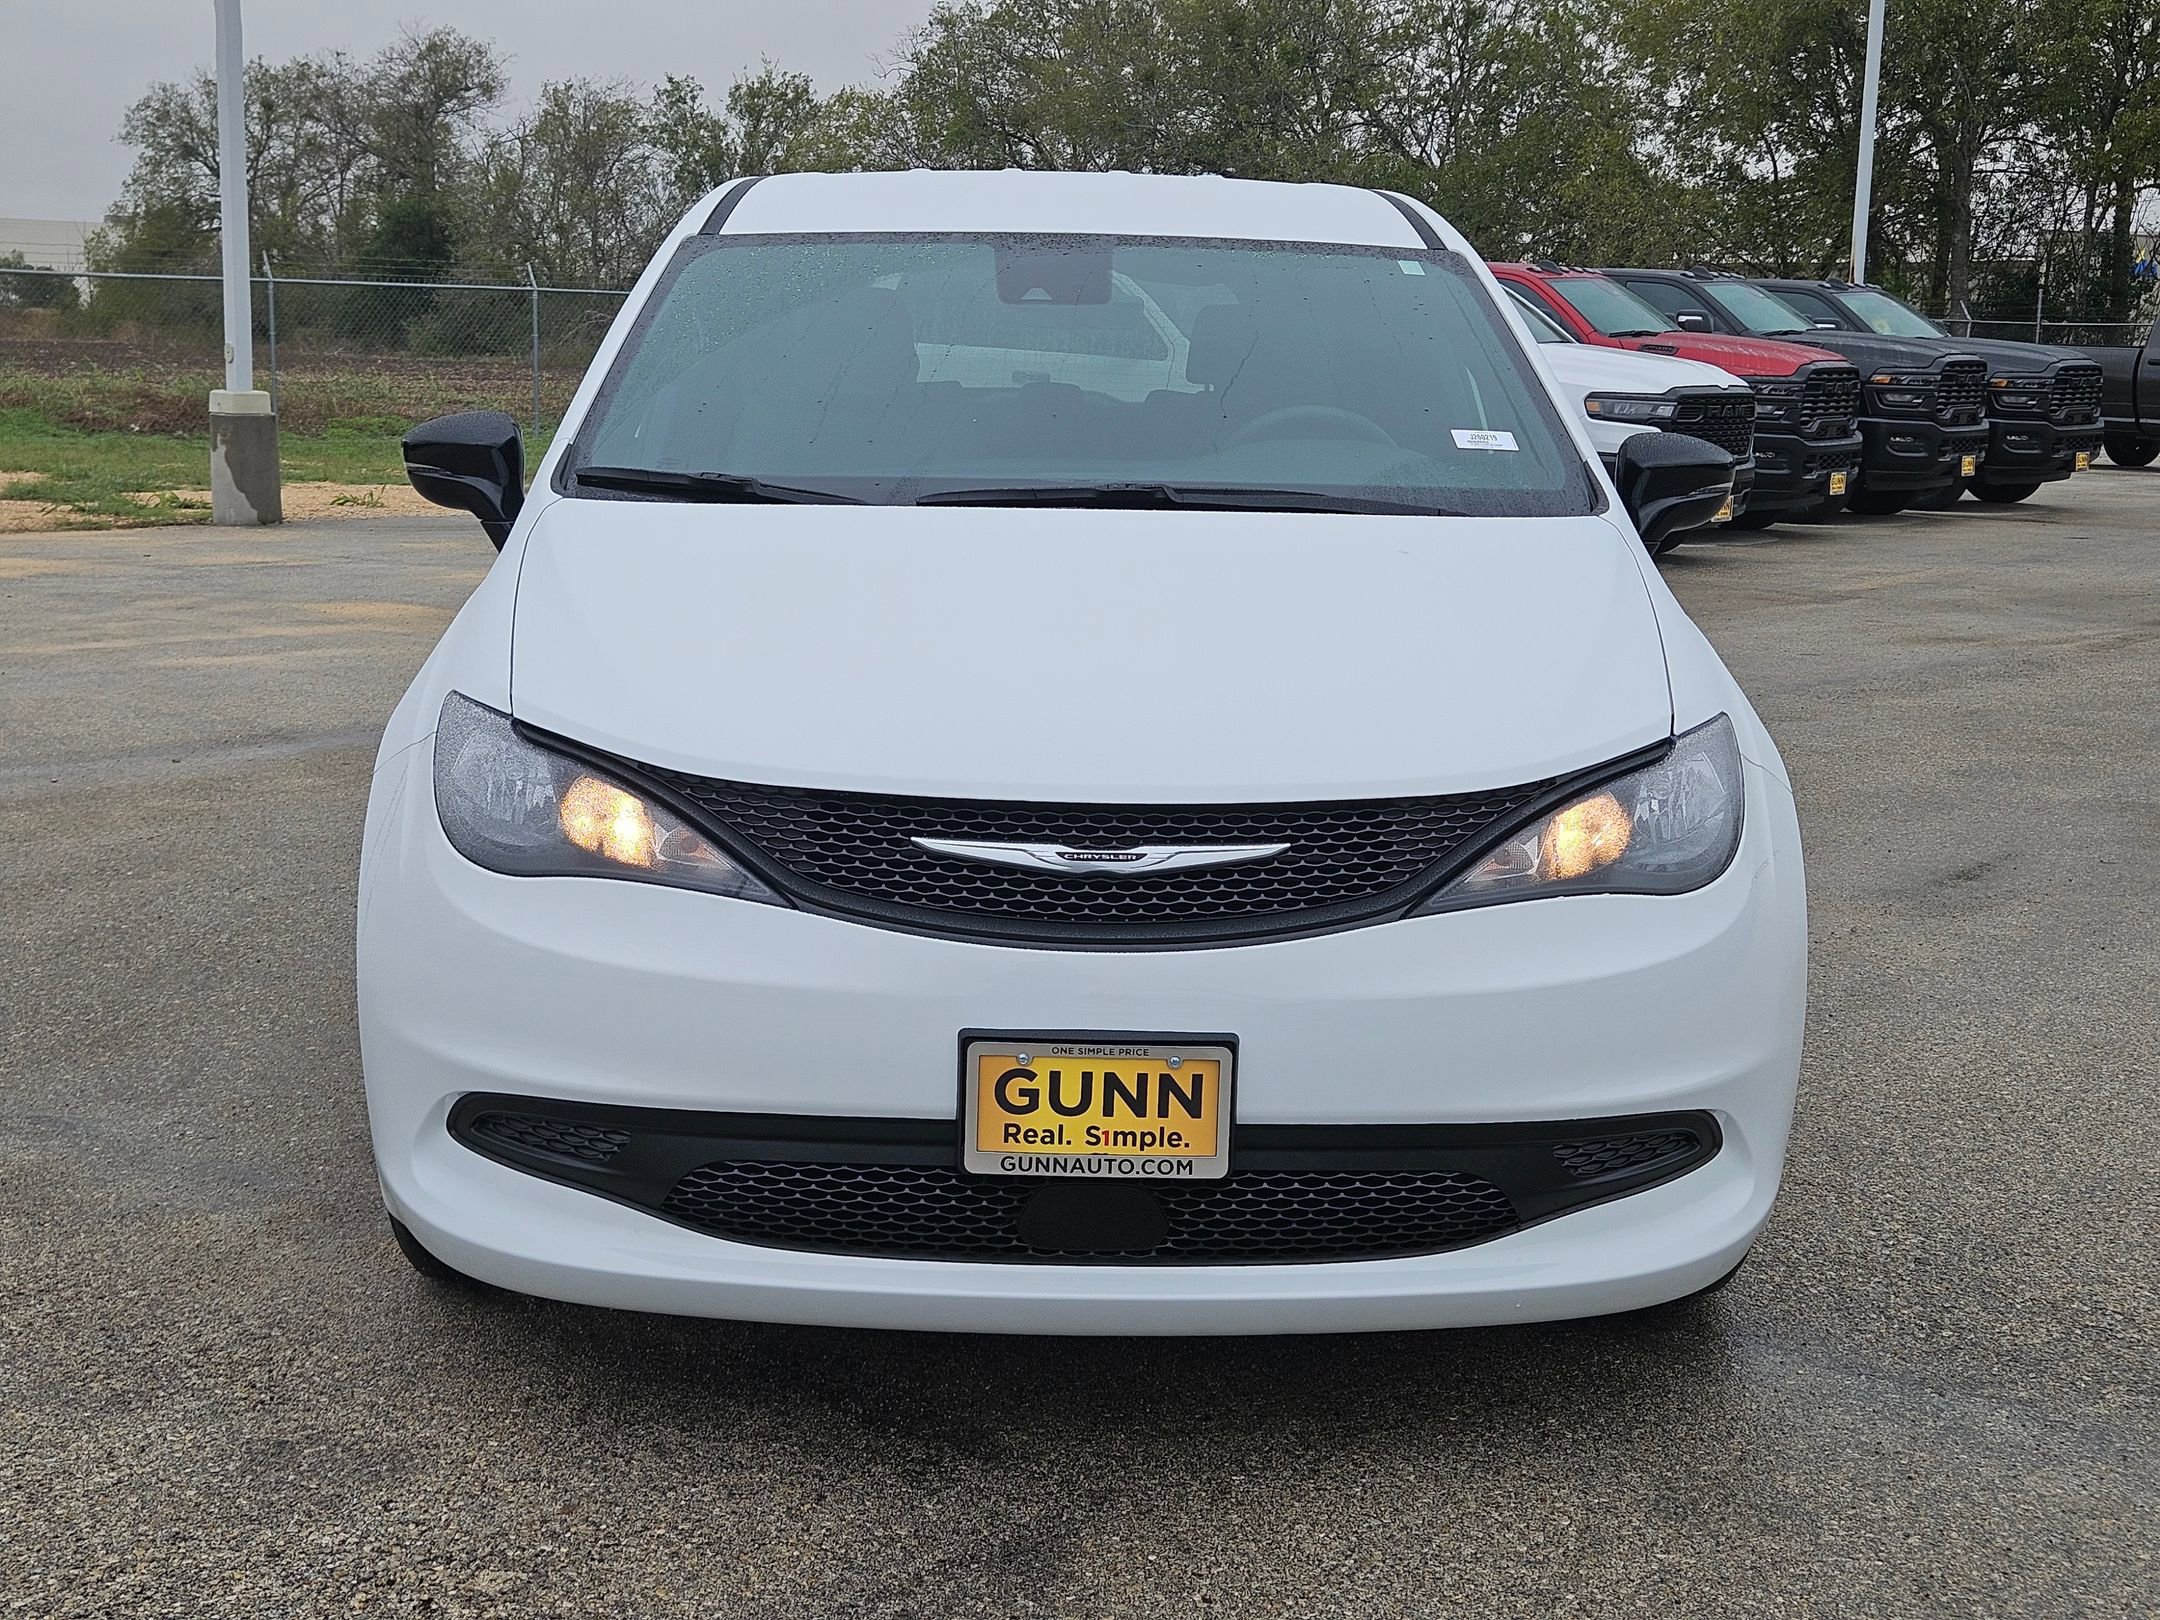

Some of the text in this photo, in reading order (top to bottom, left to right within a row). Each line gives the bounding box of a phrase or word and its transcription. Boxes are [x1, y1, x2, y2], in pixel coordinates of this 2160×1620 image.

[1051, 1046, 1149, 1057] ONE SIMPLE PRICE
[994, 1068, 1204, 1119] GUNN
[1003, 1123, 1072, 1145] Real.
[1000, 1156, 1193, 1175] GUNNAUTO.COM
